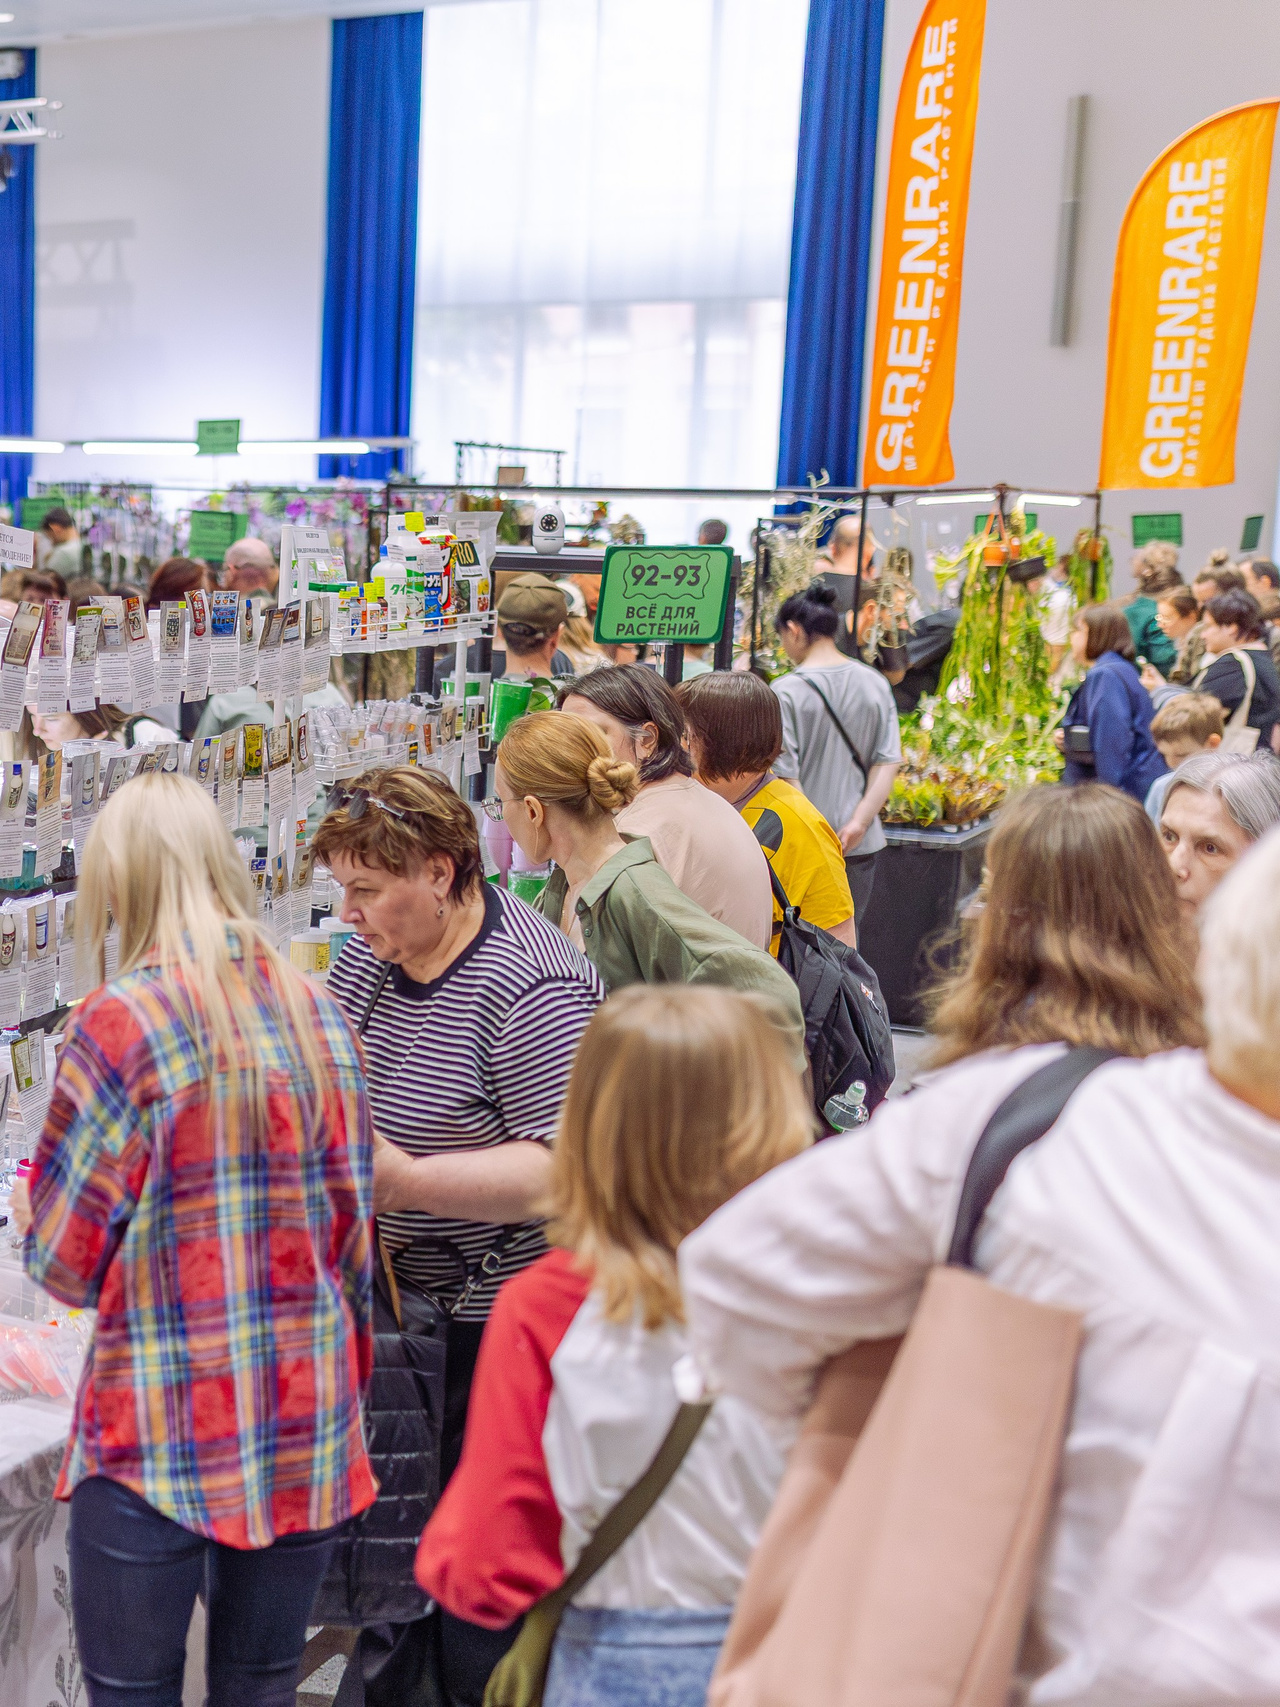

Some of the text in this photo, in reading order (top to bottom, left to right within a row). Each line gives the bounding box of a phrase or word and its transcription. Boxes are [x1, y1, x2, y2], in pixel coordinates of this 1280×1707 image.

[874, 20, 949, 472] GREENRARE
[1139, 158, 1212, 479] GREENRARE
[631, 565, 702, 587] 92-93
[625, 603, 696, 621] ВСЁ ДЛЯ
[615, 620, 700, 636] РАСТЕНИЙ
